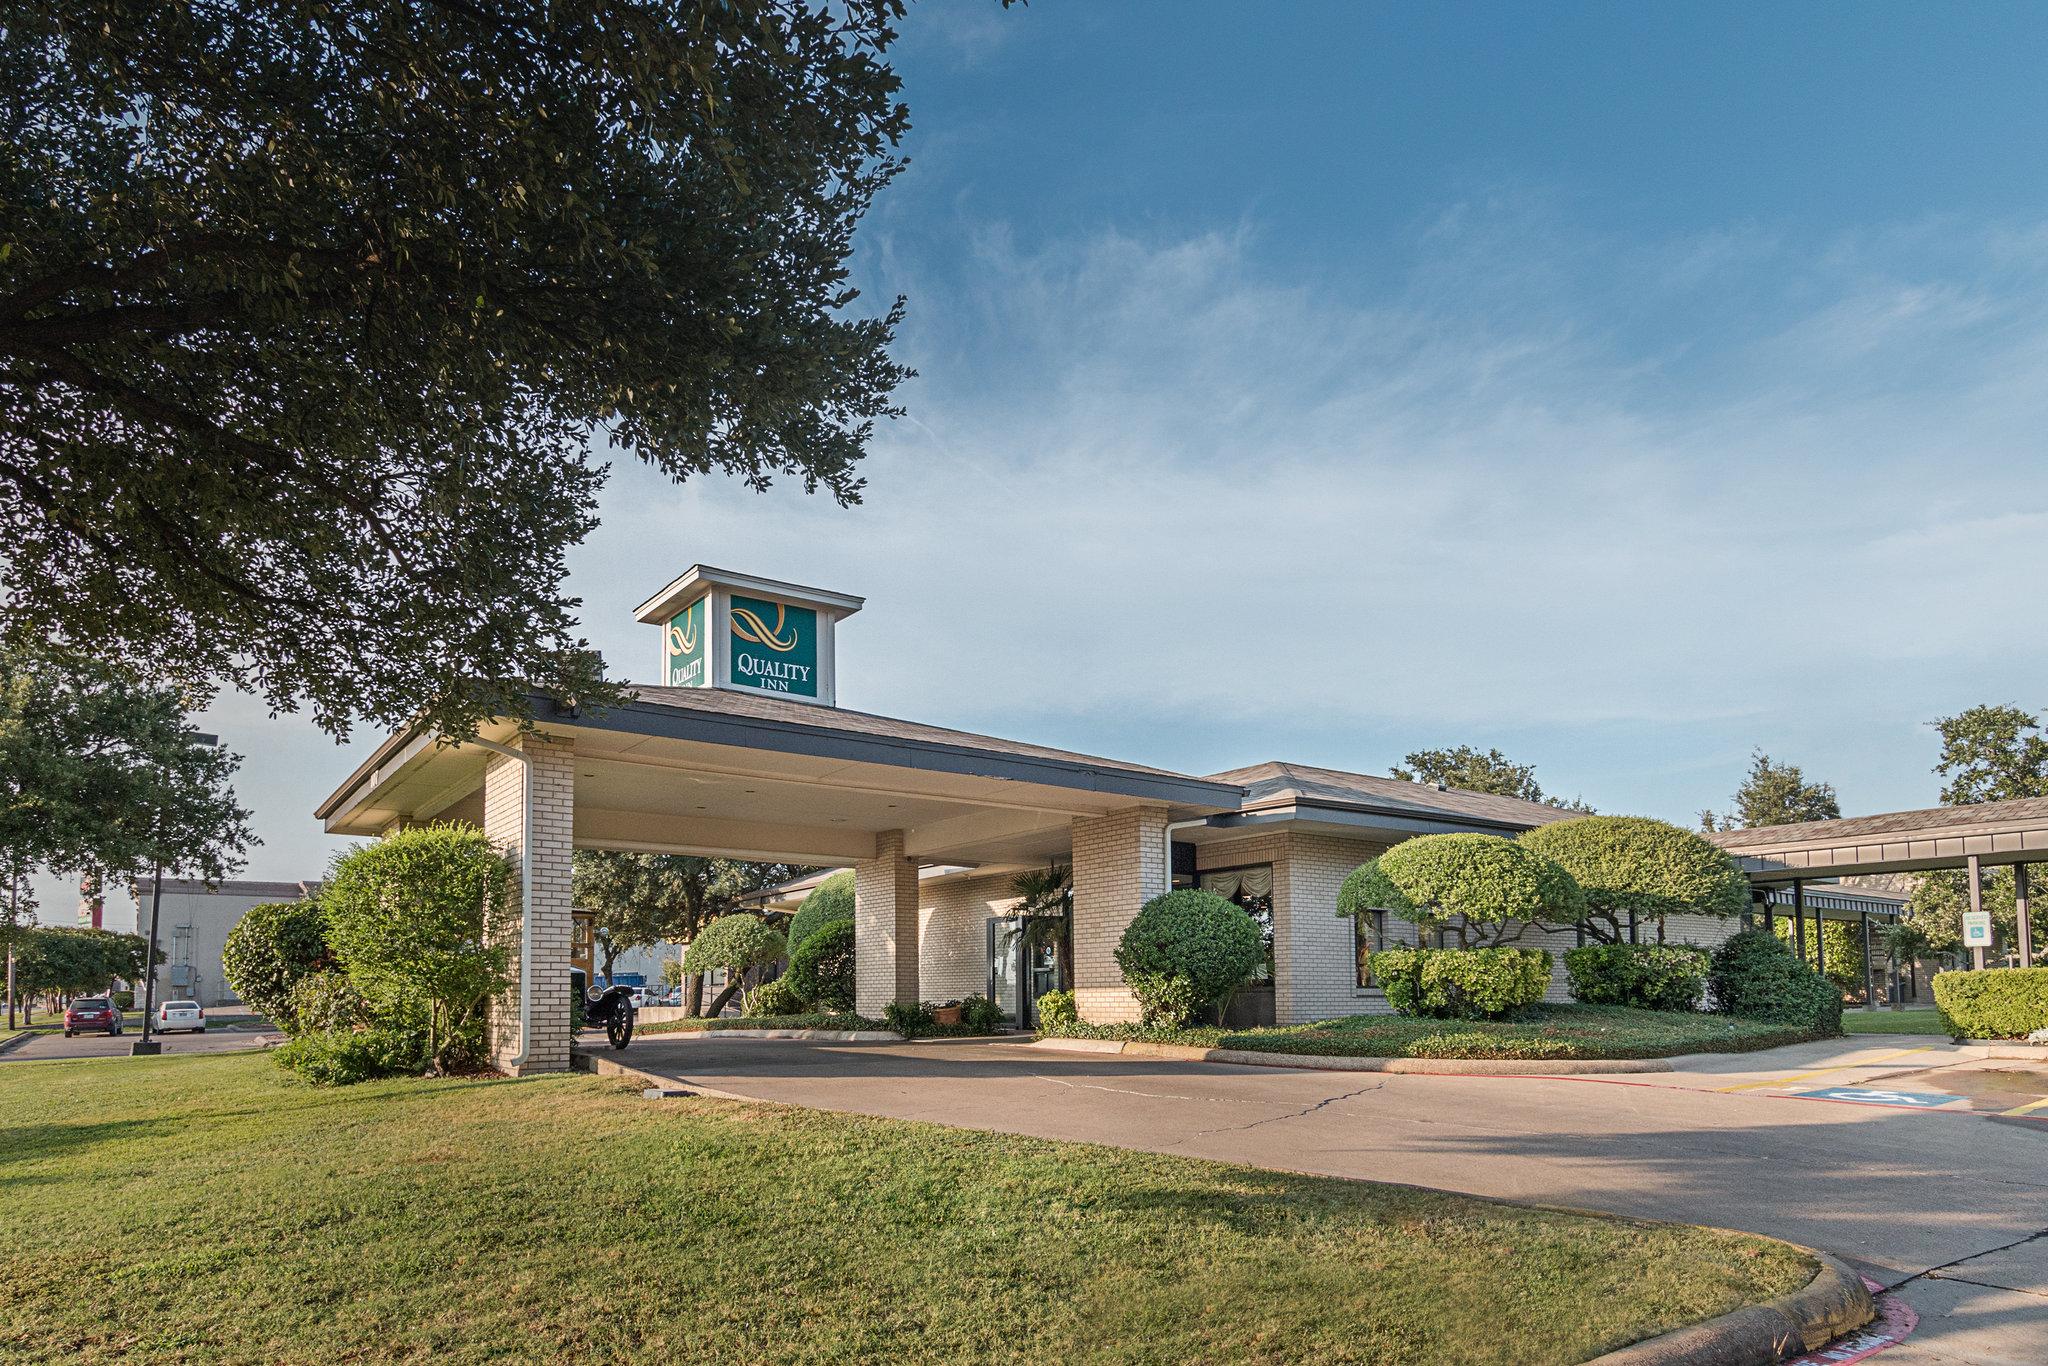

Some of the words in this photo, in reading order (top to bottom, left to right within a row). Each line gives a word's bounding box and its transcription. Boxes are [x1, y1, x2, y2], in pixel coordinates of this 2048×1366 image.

[672, 657, 702, 687] QUALITY
[738, 653, 810, 682] QUALITY
[760, 678, 789, 692] INN
